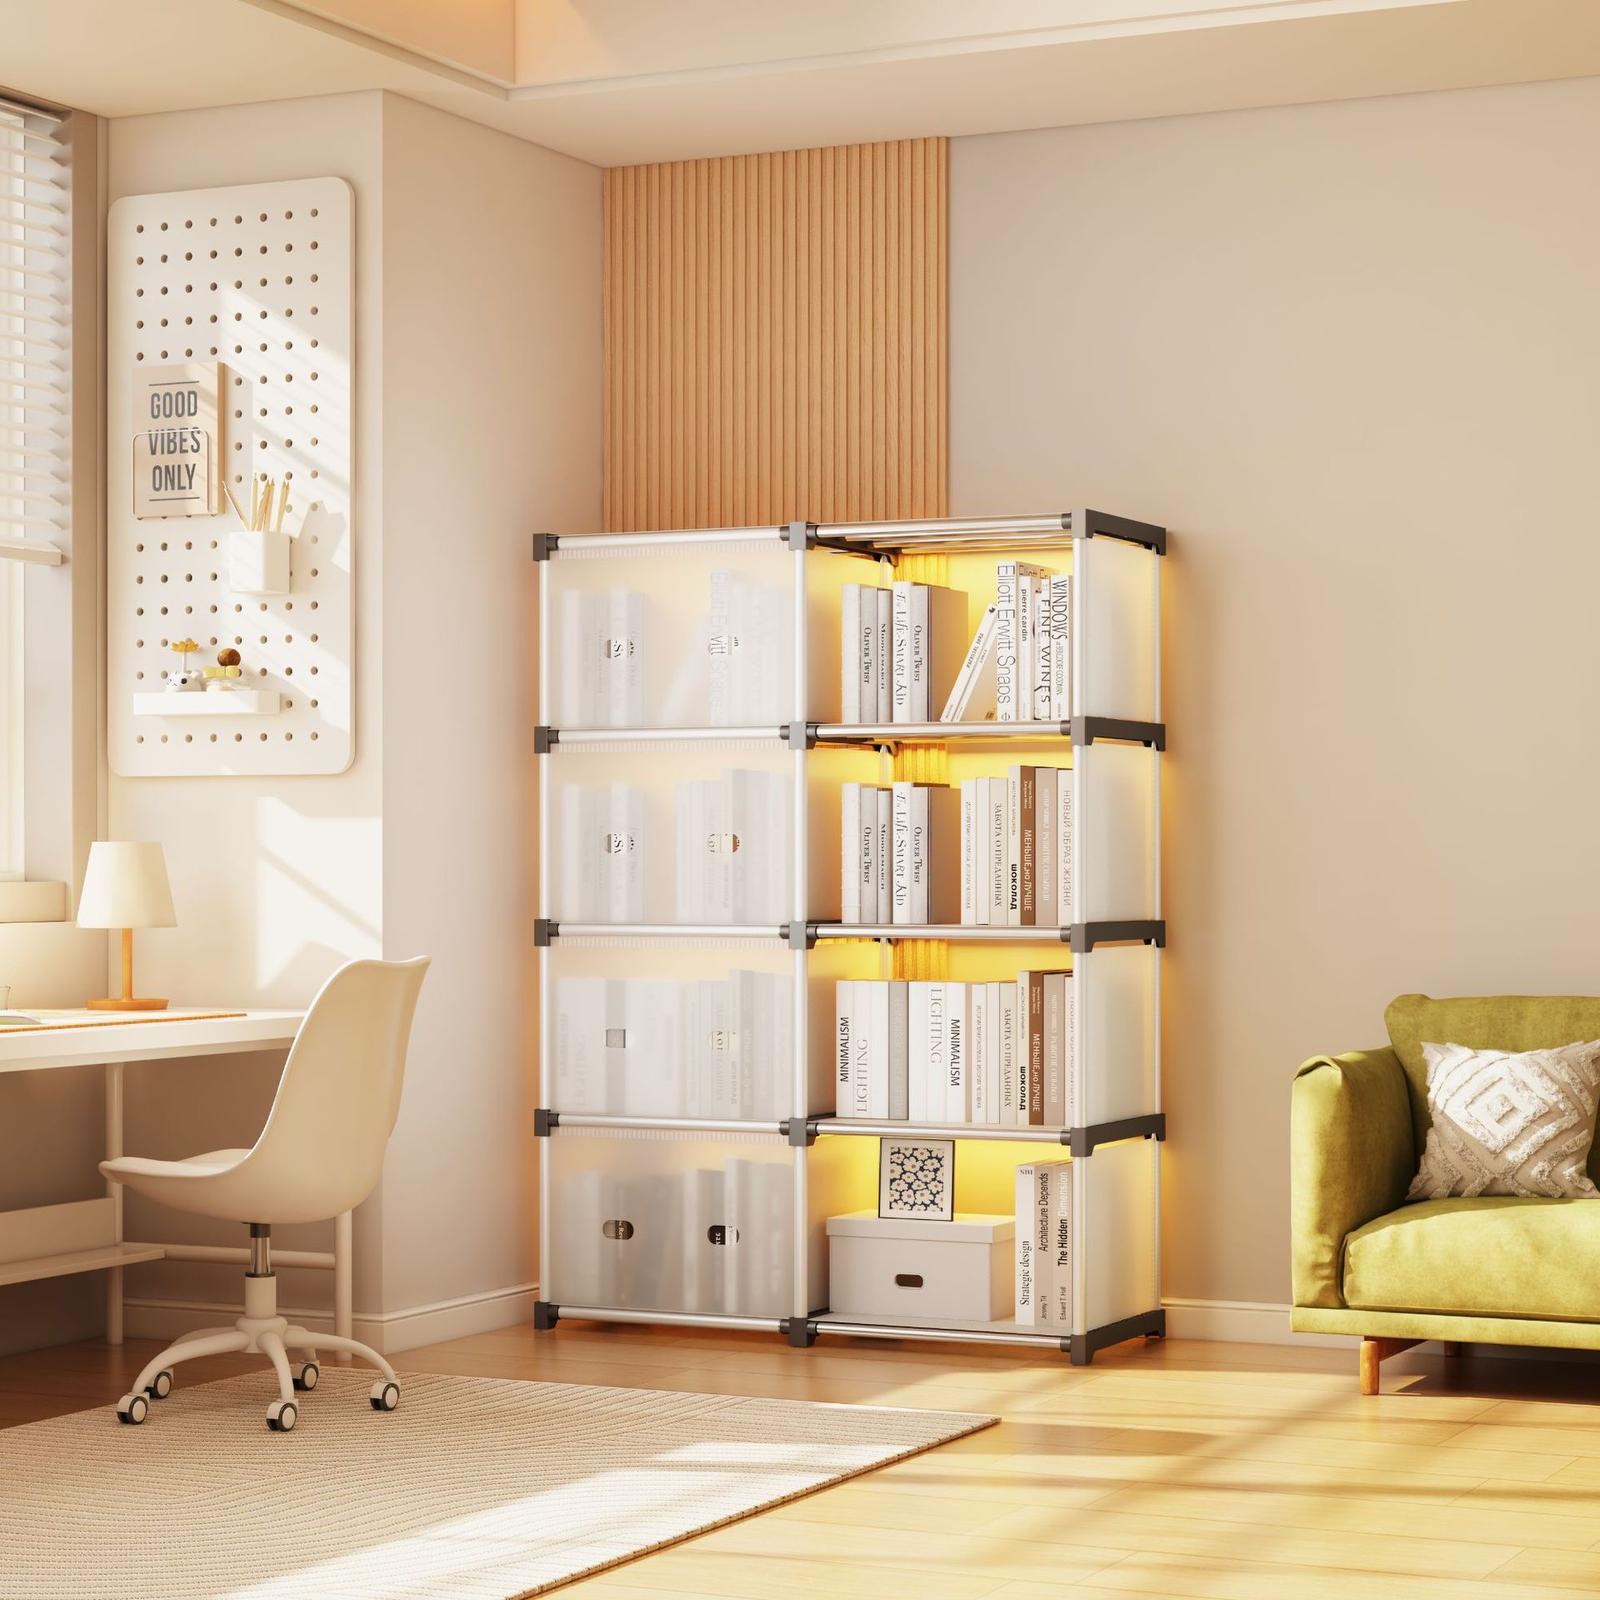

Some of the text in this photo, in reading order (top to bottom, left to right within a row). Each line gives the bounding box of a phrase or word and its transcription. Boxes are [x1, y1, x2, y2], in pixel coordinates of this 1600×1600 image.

[150, 390, 198, 419] GOOD
[148, 426, 201, 456] VIBES
[152, 463, 197, 492] ONLY
[997, 564, 1016, 604] Elliott
[1051, 579, 1069, 641] WINDOWS
[997, 608, 1016, 651] Erwitt
[1021, 615, 1029, 642] cardin
[1040, 599, 1051, 638] FINE
[863, 626, 873, 685] OLIVER TWIST
[913, 625, 923, 683] OLIVER TWIST
[1040, 644, 1051, 703] WINES
[863, 826, 873, 884] OLIVER TWIST
[913, 826, 923, 884] OLIVER TWIST
[1010, 863, 1018, 910] ШОКОЛАД
[839, 1016, 850, 1082] MINIMALISM
[930, 988, 943, 1064] LIGHTING
[950, 1018, 961, 1087] MINIMALISM
[856, 1039, 868, 1112] LIGHTING
[1019, 1066, 1027, 1111] ШОКОЛАД
[1038, 1172, 1051, 1252] Architecture Depends
[1057, 1218, 1068, 1249] Hidden
[1019, 1240, 1032, 1306] Strategic design
[1057, 1250, 1068, 1267] The
